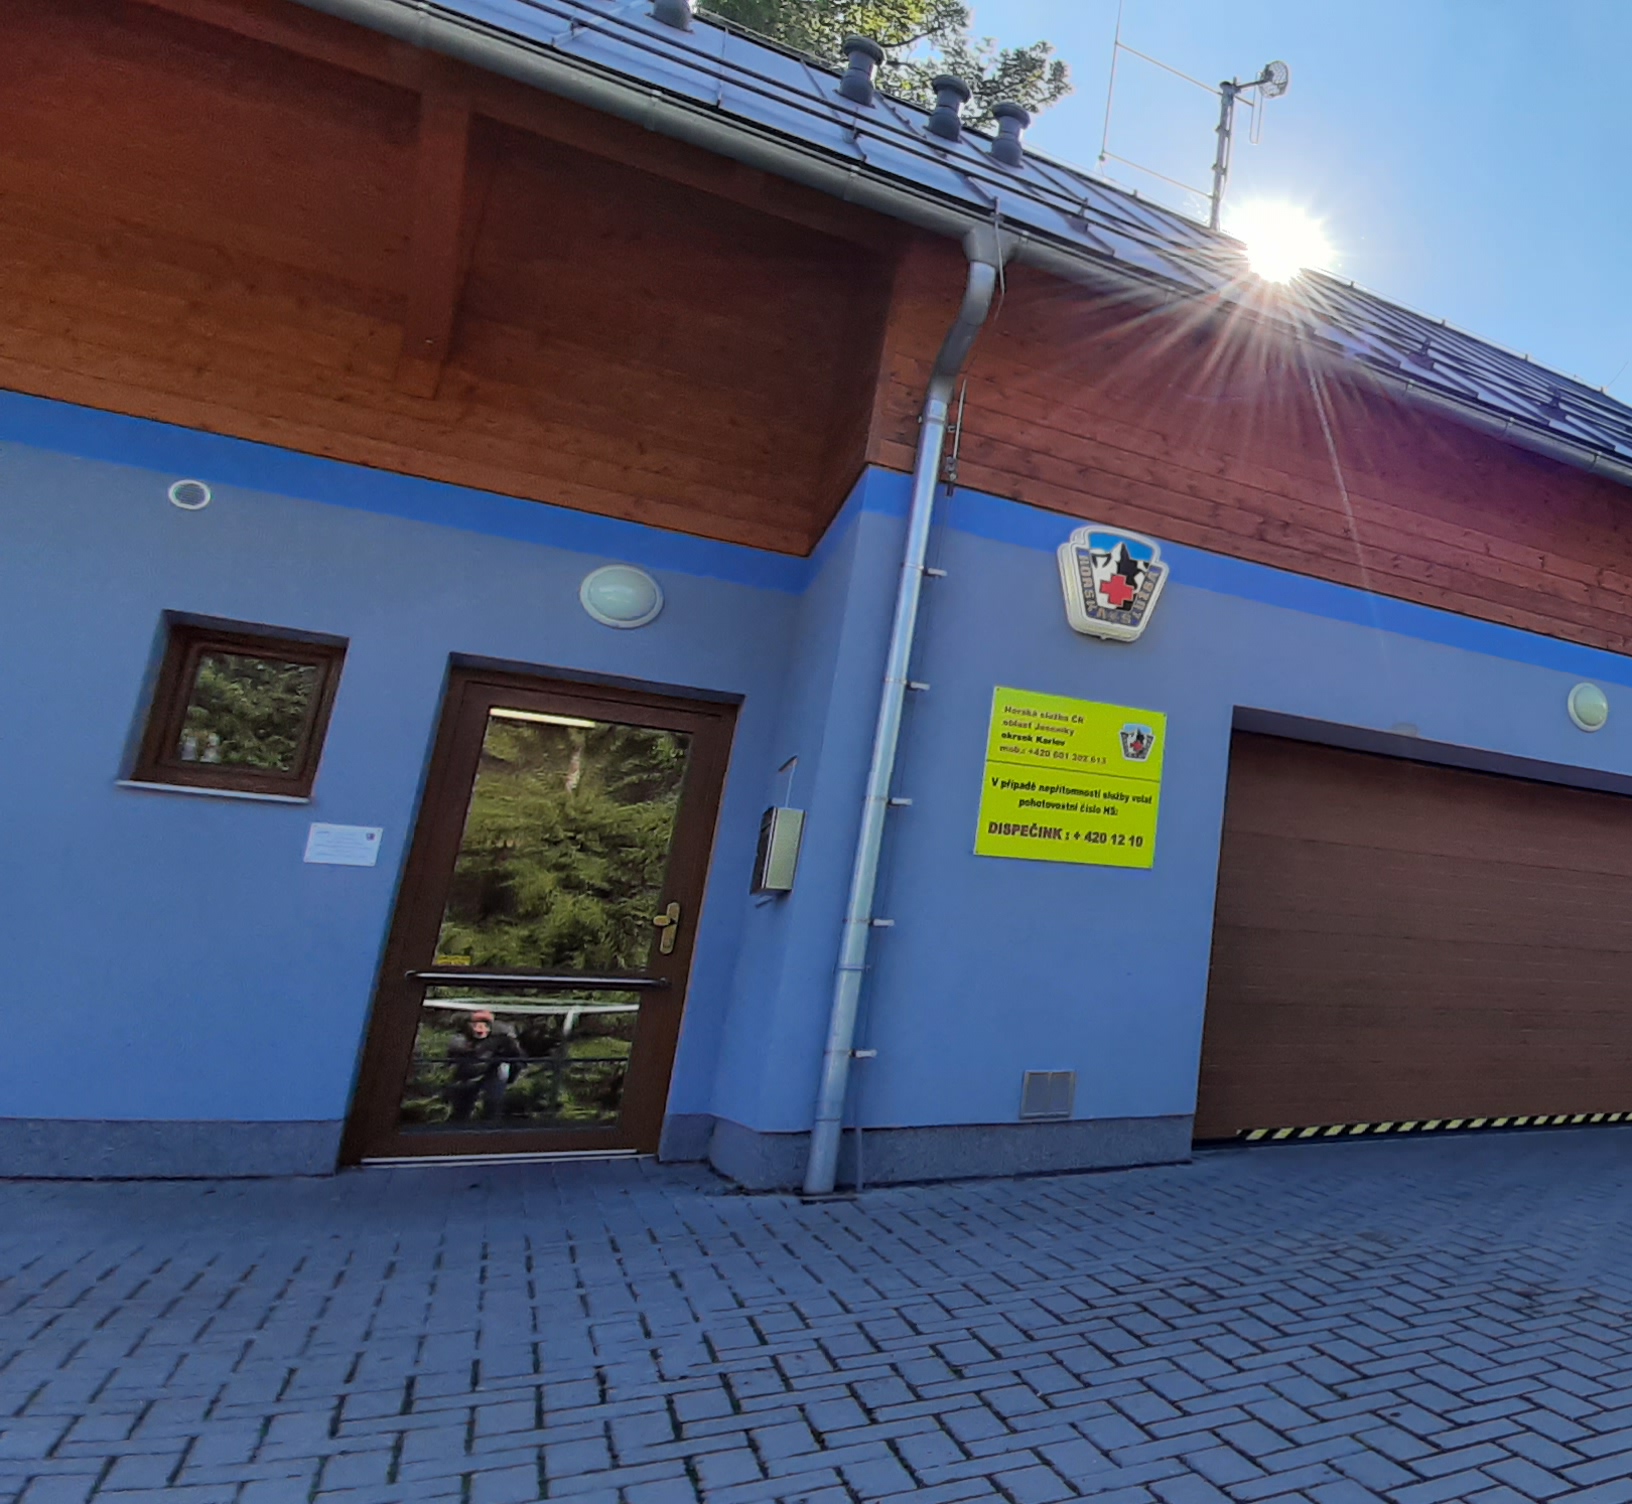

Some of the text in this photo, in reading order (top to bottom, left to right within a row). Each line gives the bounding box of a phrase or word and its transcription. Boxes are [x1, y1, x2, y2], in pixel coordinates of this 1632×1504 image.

[1004, 705, 1037, 718] Horská
[1071, 713, 1084, 724] ČR
[1003, 719, 1032, 729] oblast
[1001, 731, 1066, 747] okrsek Karlov
[1028, 748, 1051, 758] +420
[991, 777, 999, 787] V
[1001, 779, 1037, 792] případě
[1103, 791, 1130, 804] služby
[1018, 798, 1078, 812] pohotovostní
[1080, 802, 1102, 814] číslo
[988, 821, 1064, 841] DISPEČINK
[1084, 831, 1108, 845] 420
[1110, 833, 1126, 846] 12
[1128, 835, 1144, 848] 10
